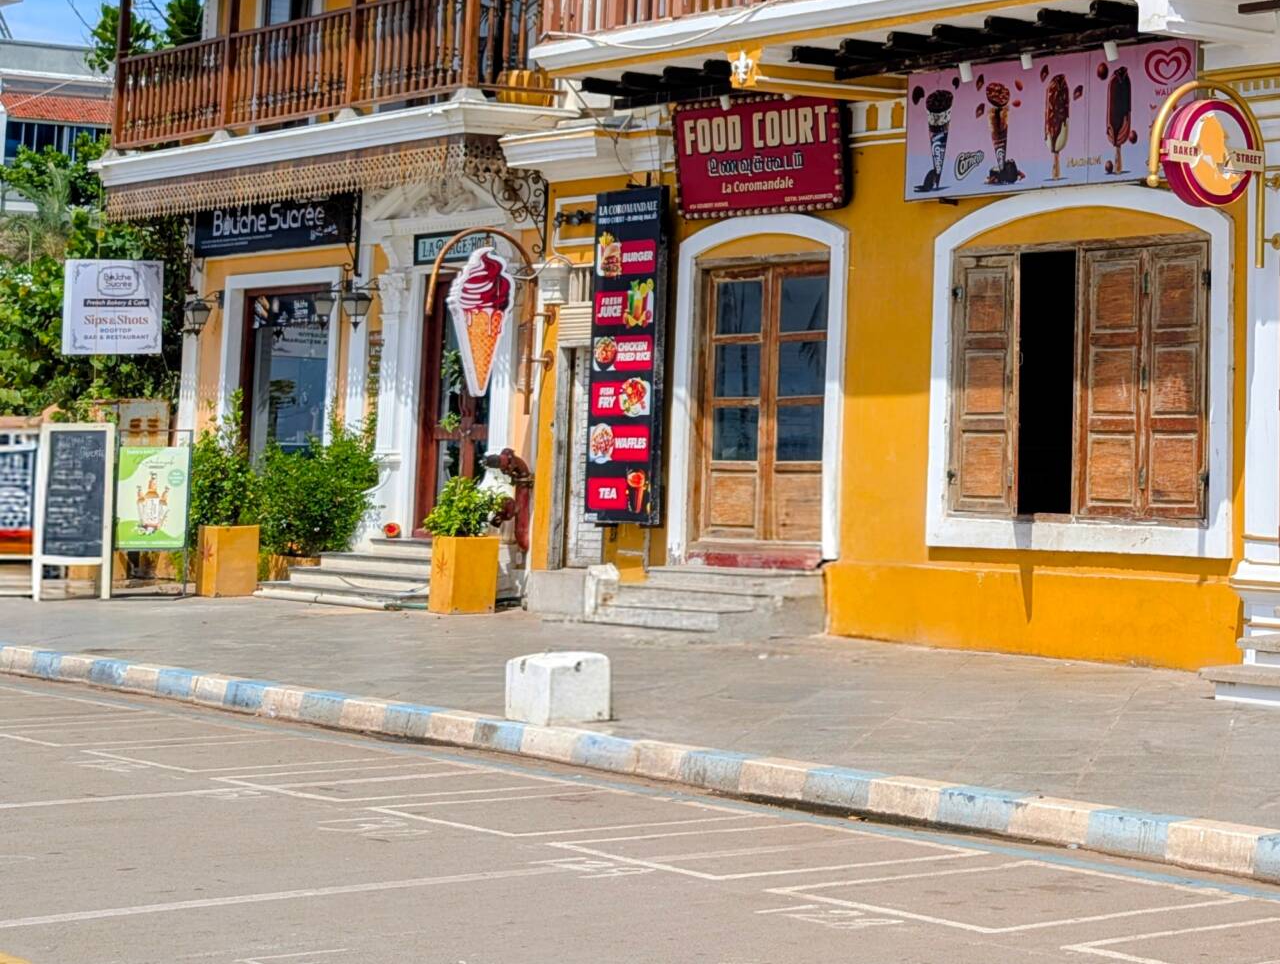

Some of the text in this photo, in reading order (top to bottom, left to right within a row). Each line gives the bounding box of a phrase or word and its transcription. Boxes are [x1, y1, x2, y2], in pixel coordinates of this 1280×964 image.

[683, 104, 828, 156] FOOD COURT
[1172, 144, 1262, 166] BAKER STREET
[721, 176, 794, 194] La Coromandale
[599, 205, 608, 216] LA
[621, 250, 654, 263] BURGER
[601, 296, 623, 306] FRESH
[598, 305, 623, 318] JUICE
[84, 314, 108, 327] Sips
[116, 315, 149, 325] Shots
[617, 341, 648, 352] CHICKEN
[616, 351, 651, 362] FRIED RICE
[599, 387, 615, 396] FISH
[598, 396, 616, 409] FRY
[614, 437, 647, 449] WAFFLES
[598, 487, 617, 499] TEA
